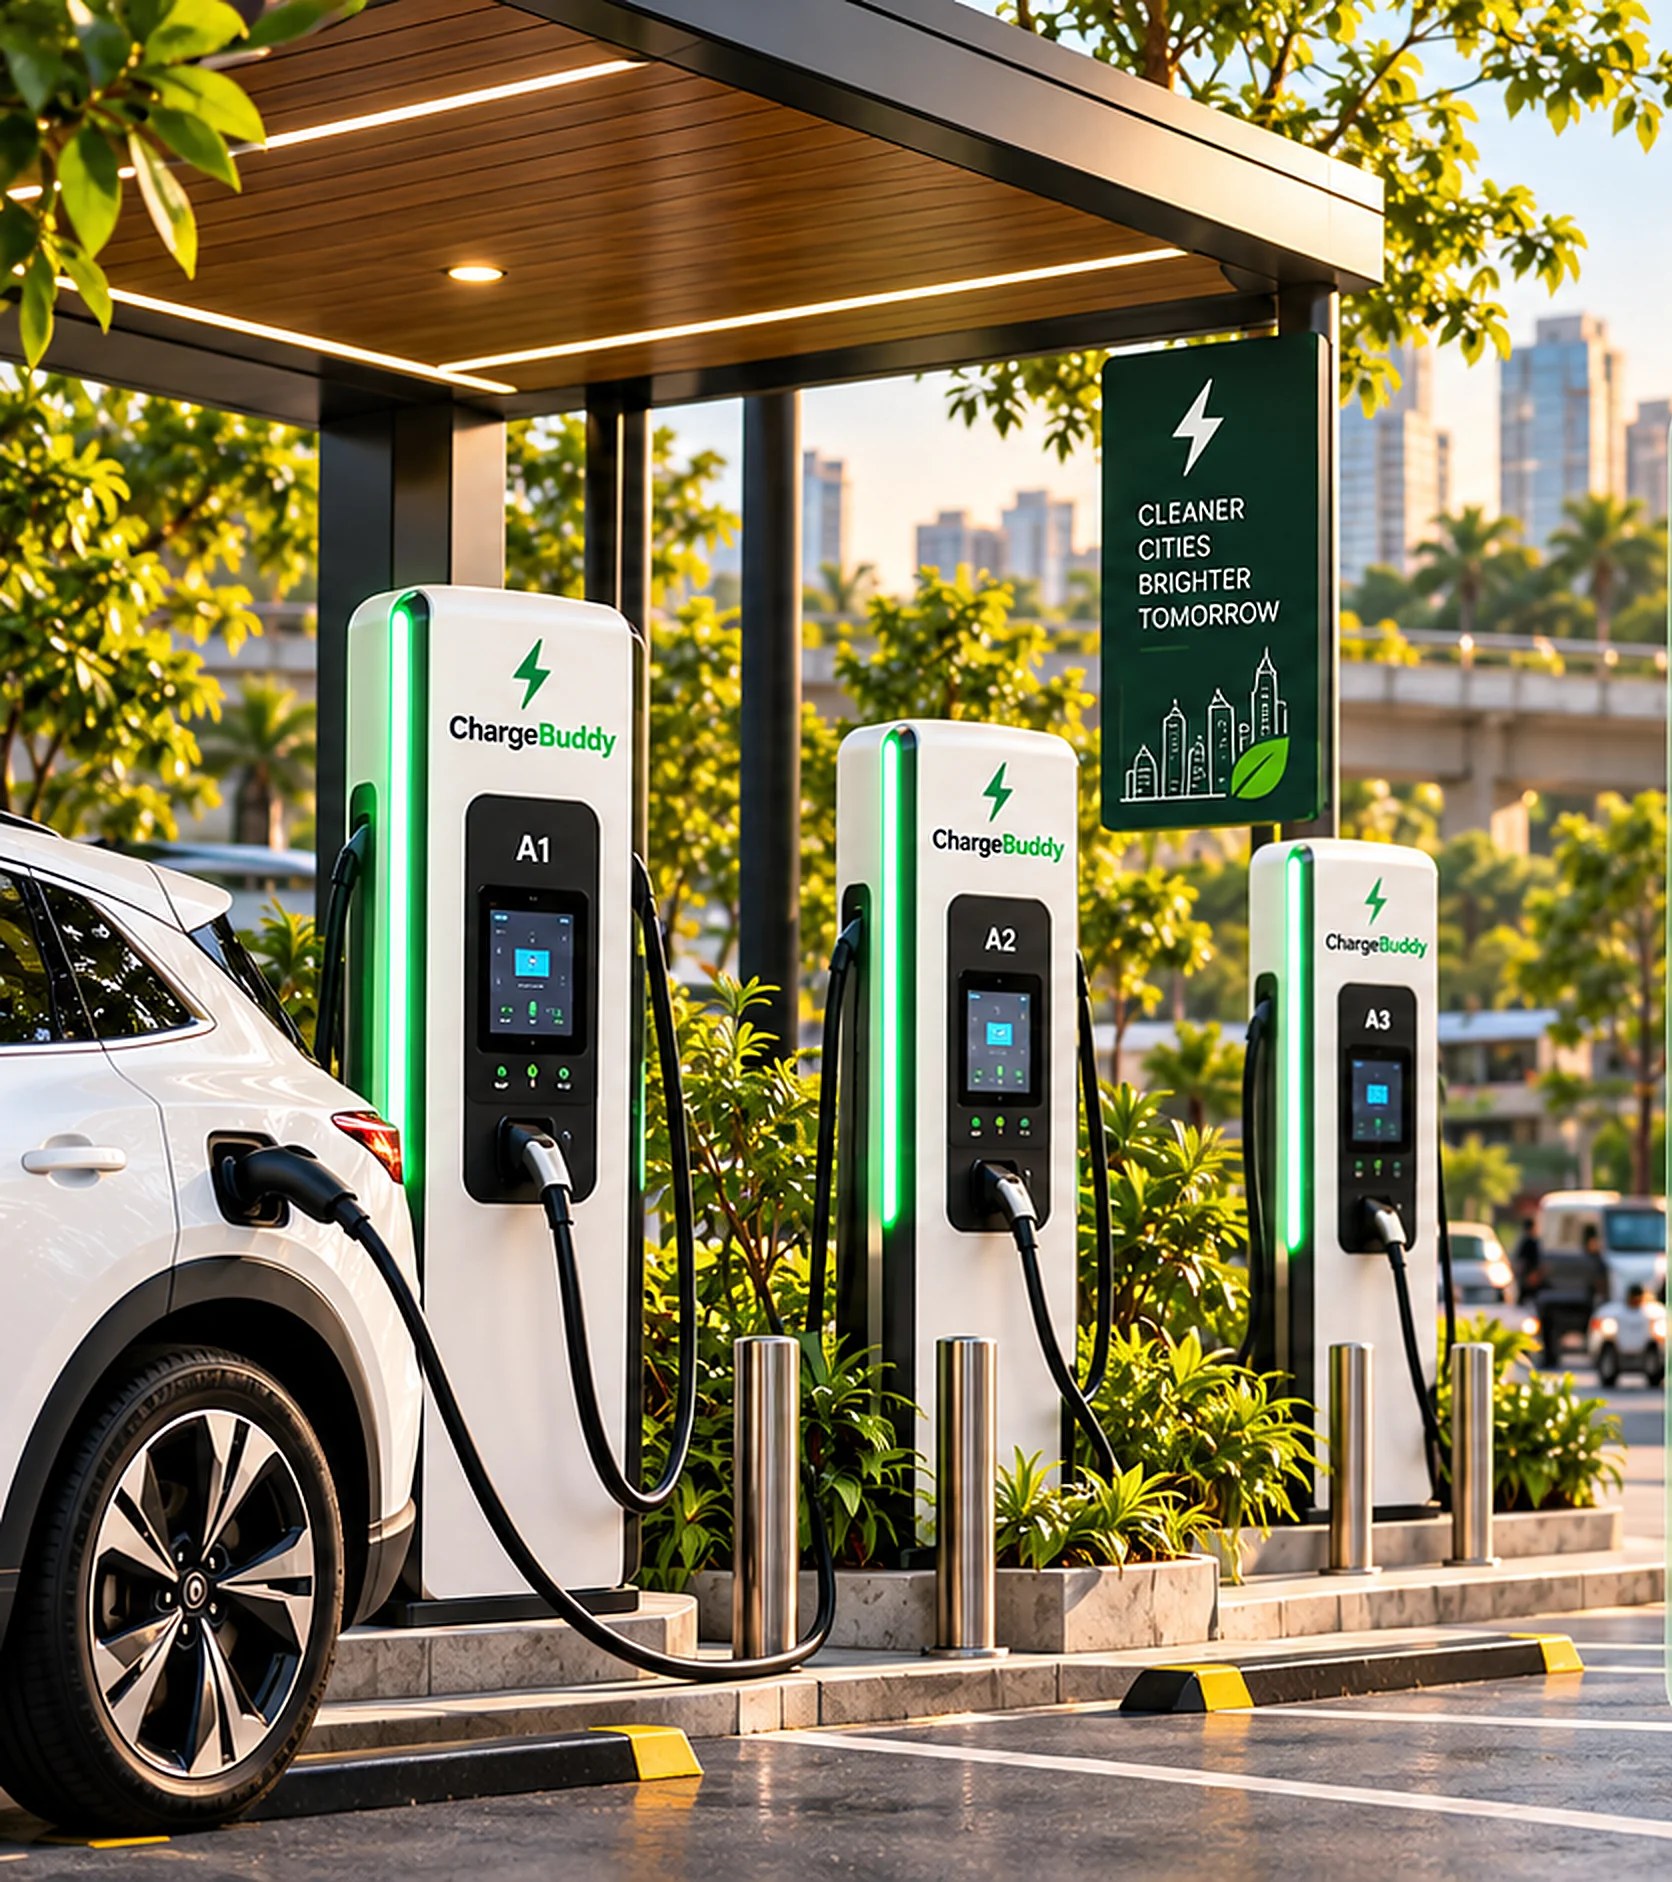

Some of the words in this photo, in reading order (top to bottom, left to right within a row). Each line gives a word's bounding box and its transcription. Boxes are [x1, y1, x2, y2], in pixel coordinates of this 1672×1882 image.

[1138, 497, 1245, 527] CLEANER
[1138, 534, 1211, 561] CITIES
[1139, 567, 1251, 596] BRIGHTER
[1138, 600, 1280, 630] TOMORROW
[449, 715, 617, 759] ChargeBuddy
[516, 834, 549, 863] A1
[932, 828, 1065, 864] ChargeBuddy
[985, 927, 1016, 952] A2
[1325, 932, 1428, 959] ChargeBuddy
[1365, 1008, 1391, 1030] A3
